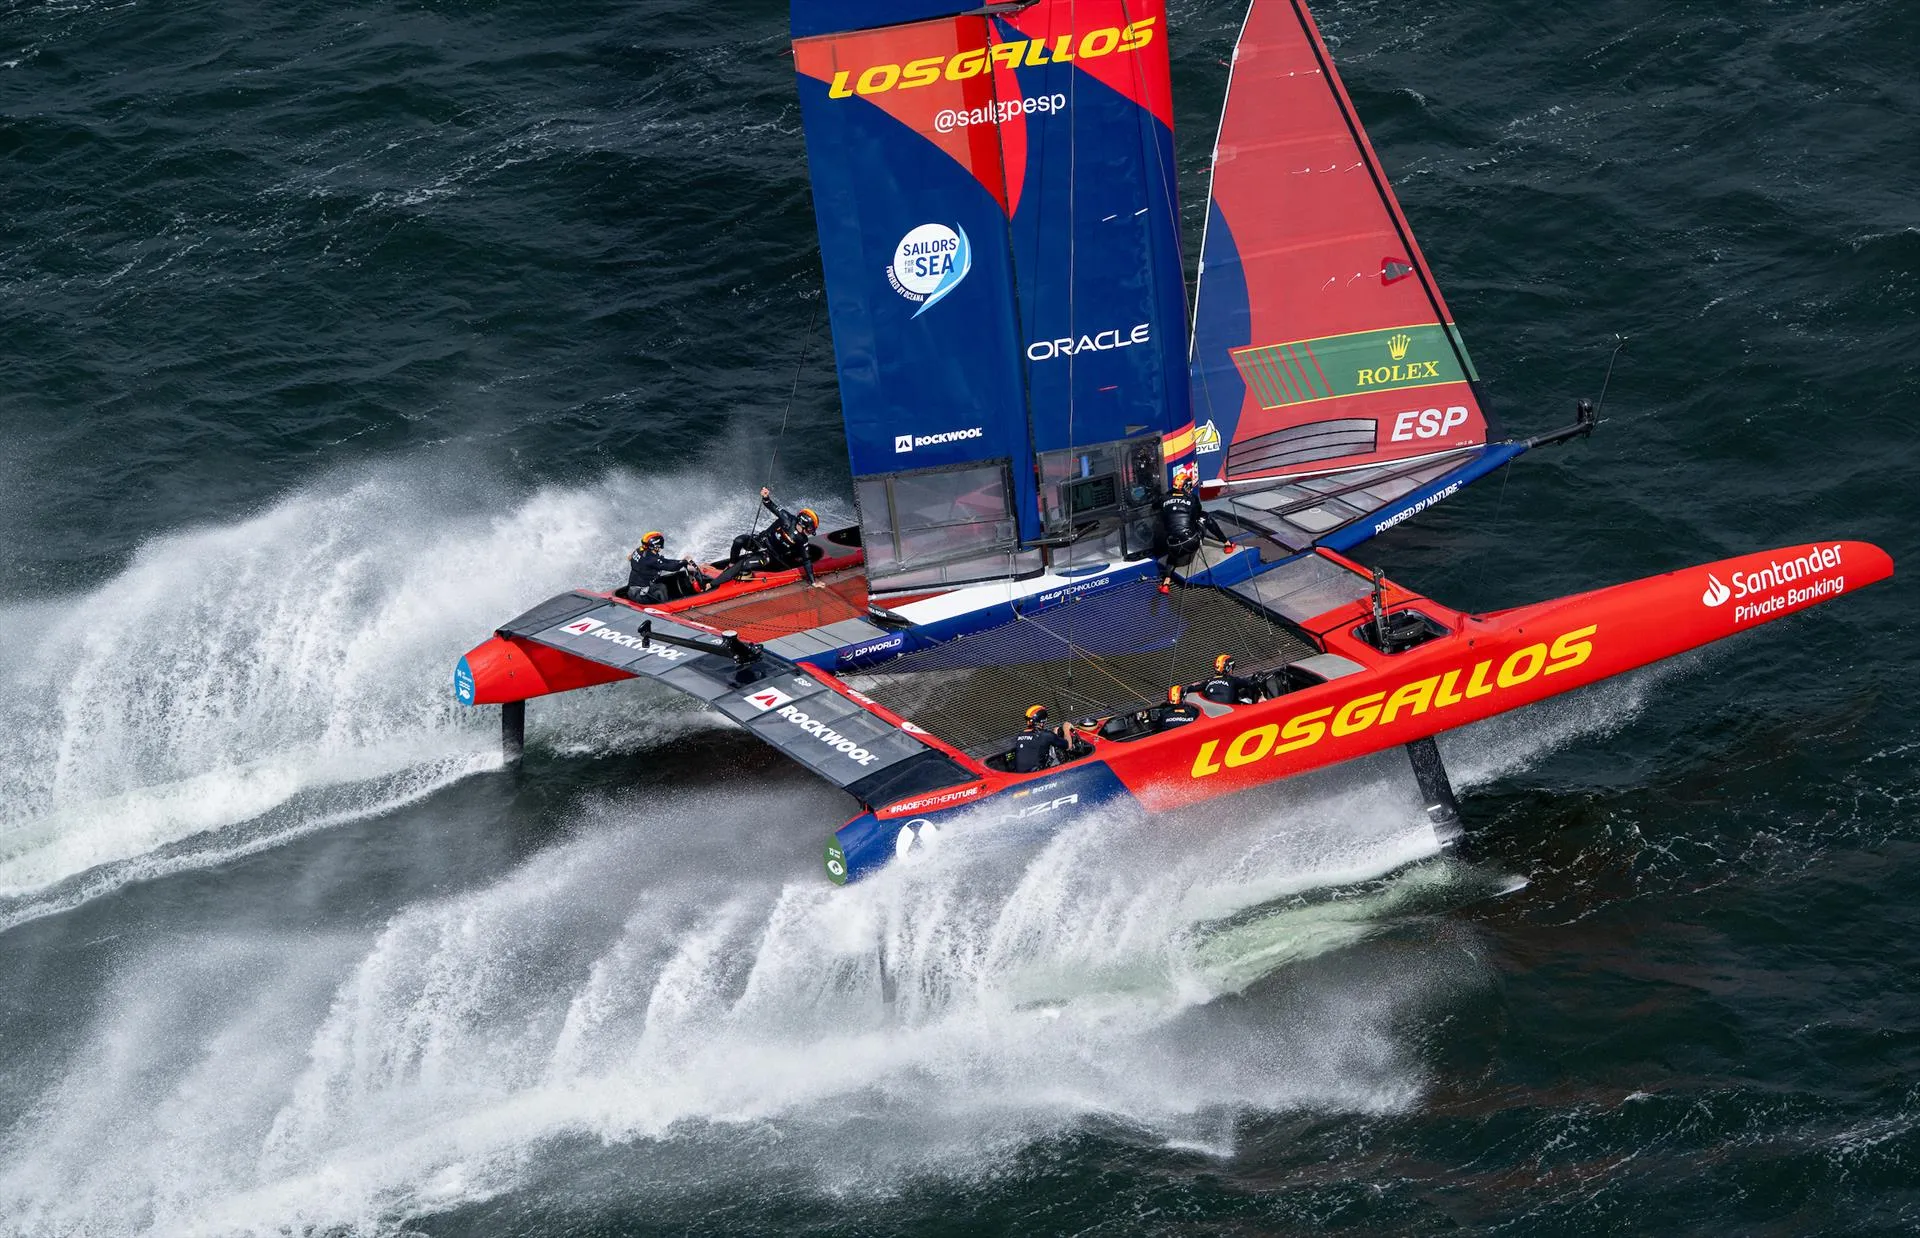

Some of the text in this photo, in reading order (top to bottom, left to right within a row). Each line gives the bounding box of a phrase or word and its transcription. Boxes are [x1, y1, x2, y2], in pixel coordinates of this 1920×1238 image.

[934, 92, 1066, 134] @sailgpesp
[903, 238, 957, 257] SAILORS
[885, 265, 898, 290] POWERED
[915, 253, 955, 277] SEA
[1027, 322, 1150, 361] ORACLE
[1356, 360, 1440, 386] ROLEX
[914, 427, 983, 447] ROCKWOOL
[1391, 406, 1469, 442] ESP
[1196, 443, 1219, 453] OYLE
[1374, 507, 1416, 535] POWERED
[1415, 500, 1426, 514] BY
[1731, 544, 1842, 599] Santander
[1062, 577, 1110, 596] TECHNOLOGIES
[1734, 576, 1844, 623] Private Banking
[855, 638, 901, 657] DP WORLD
[776, 704, 880, 767] ROCKWOOL
